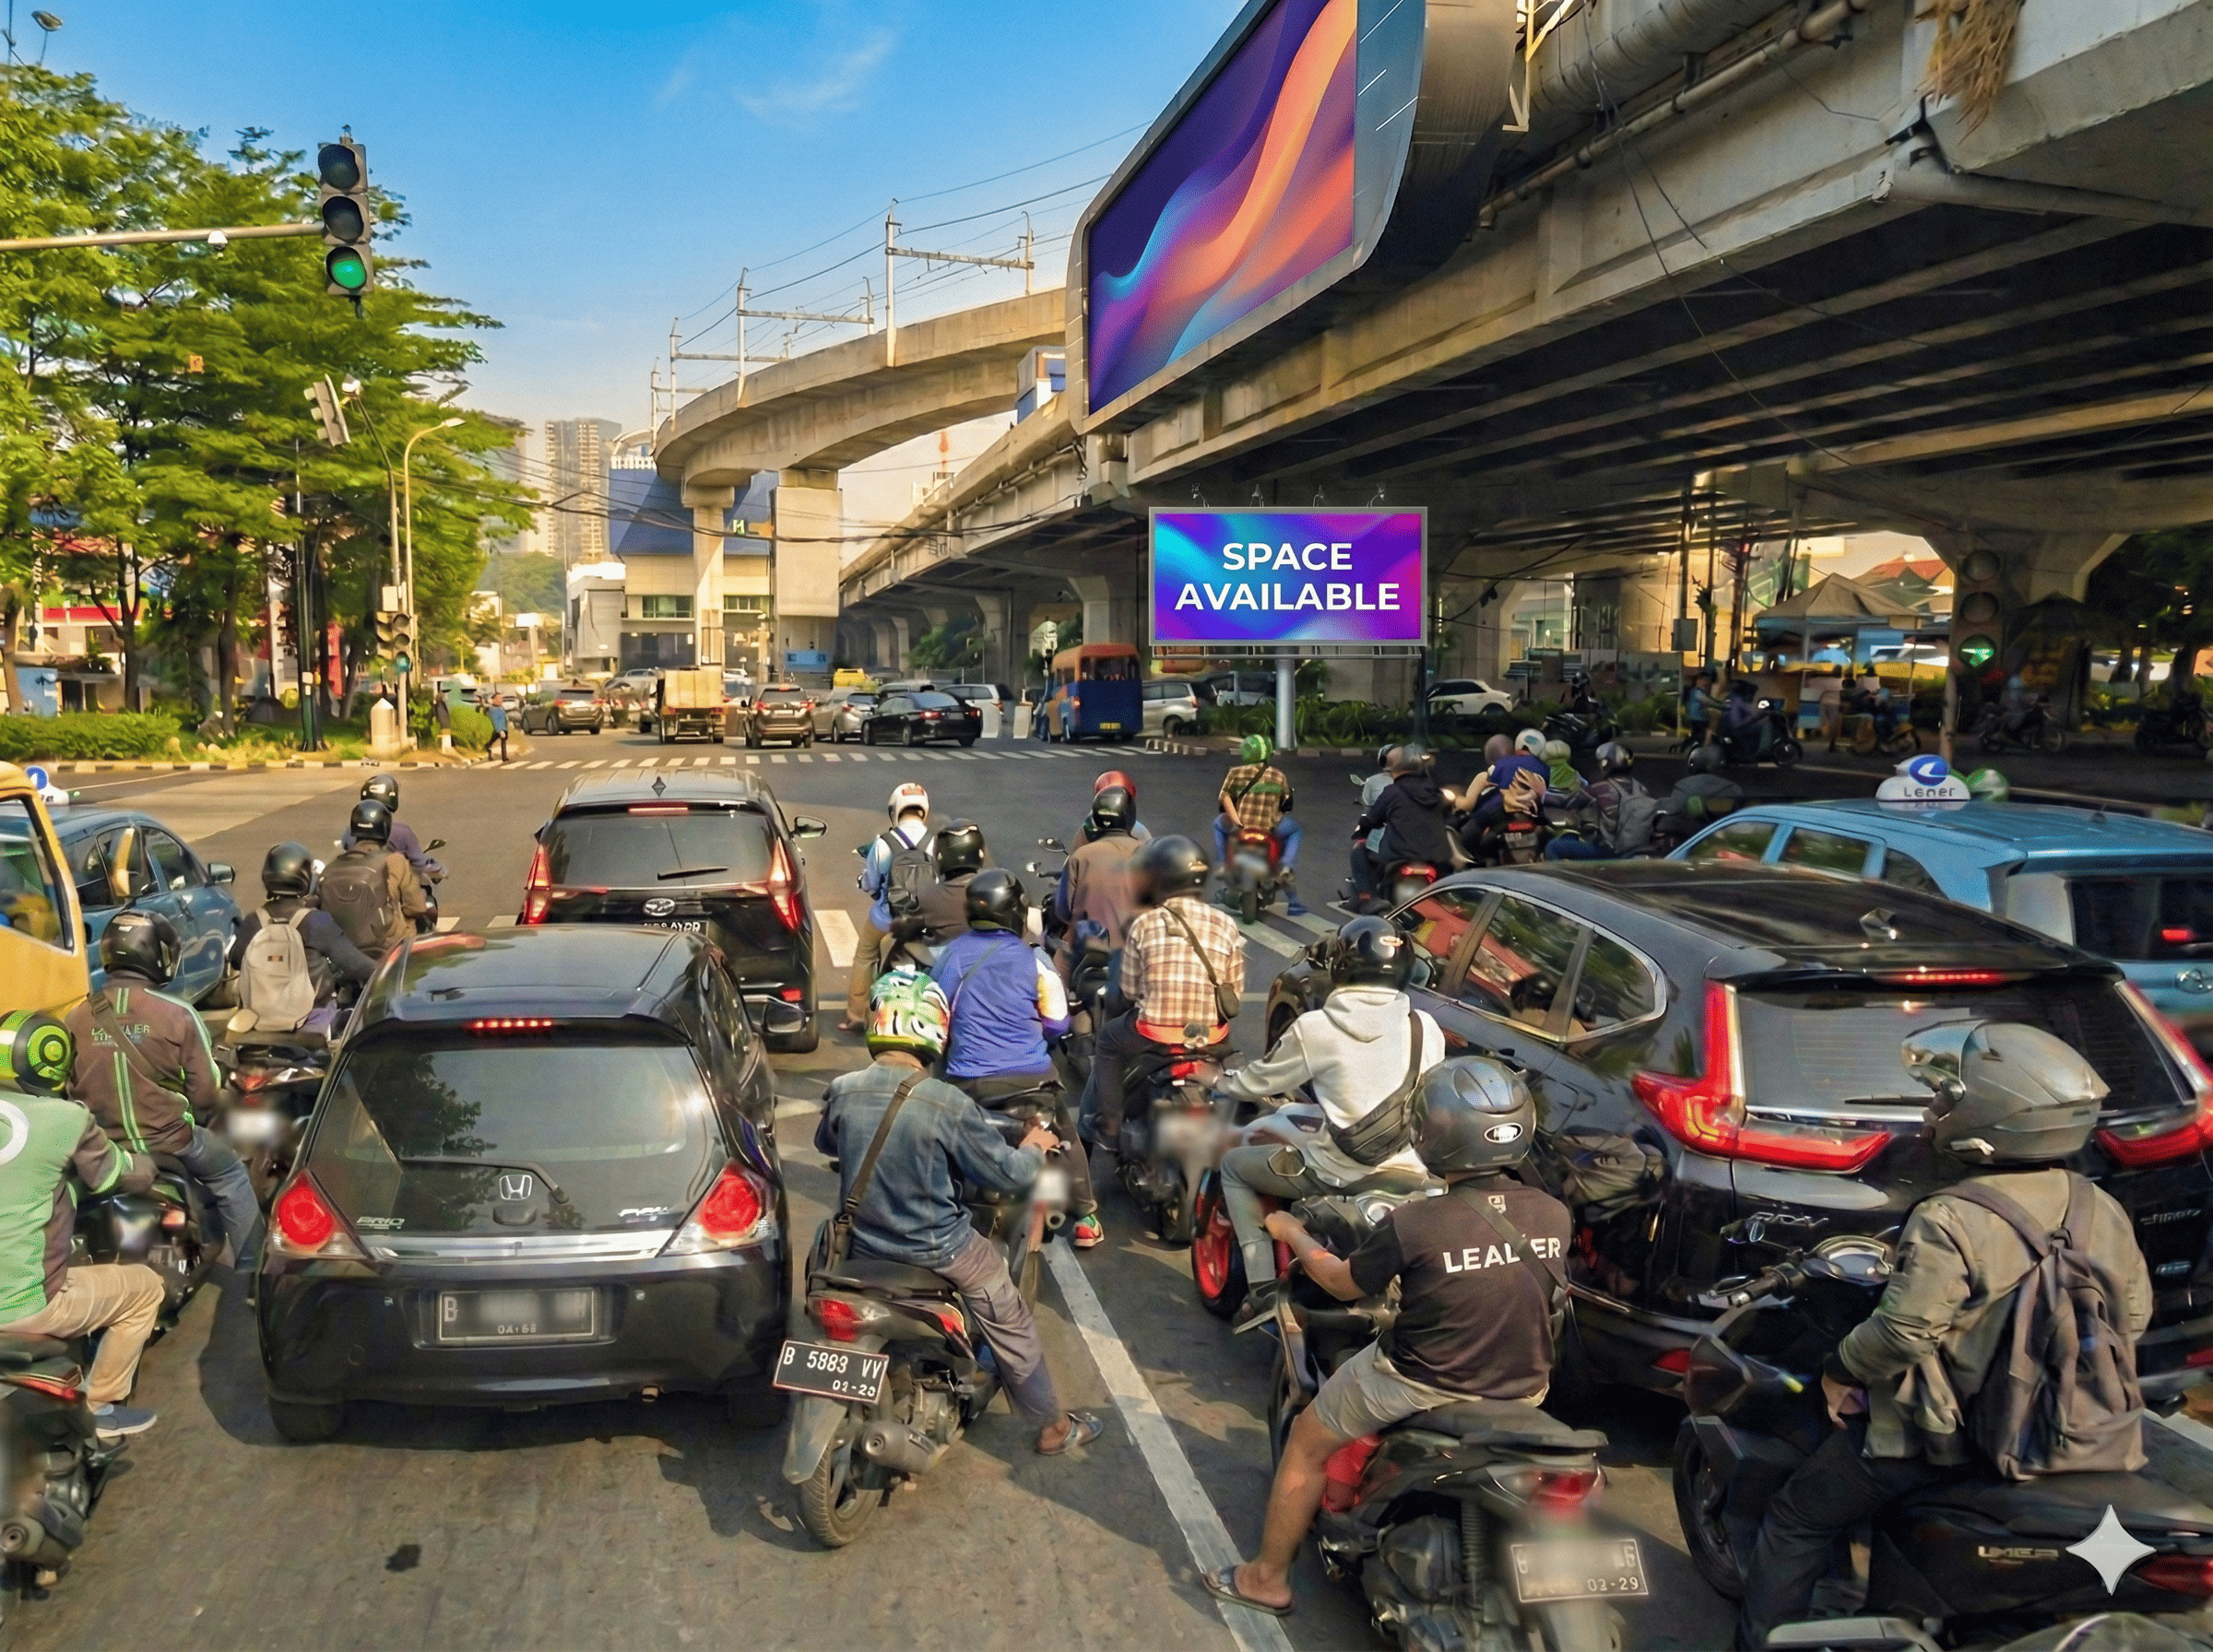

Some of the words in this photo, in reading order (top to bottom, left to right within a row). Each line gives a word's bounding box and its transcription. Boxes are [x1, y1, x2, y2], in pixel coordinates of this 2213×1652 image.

[1223, 542, 1353, 571] SPACE
[1175, 583, 1401, 610] AVAILABLE
[783, 1347, 796, 1365] B
[807, 1351, 848, 1374] 5883
